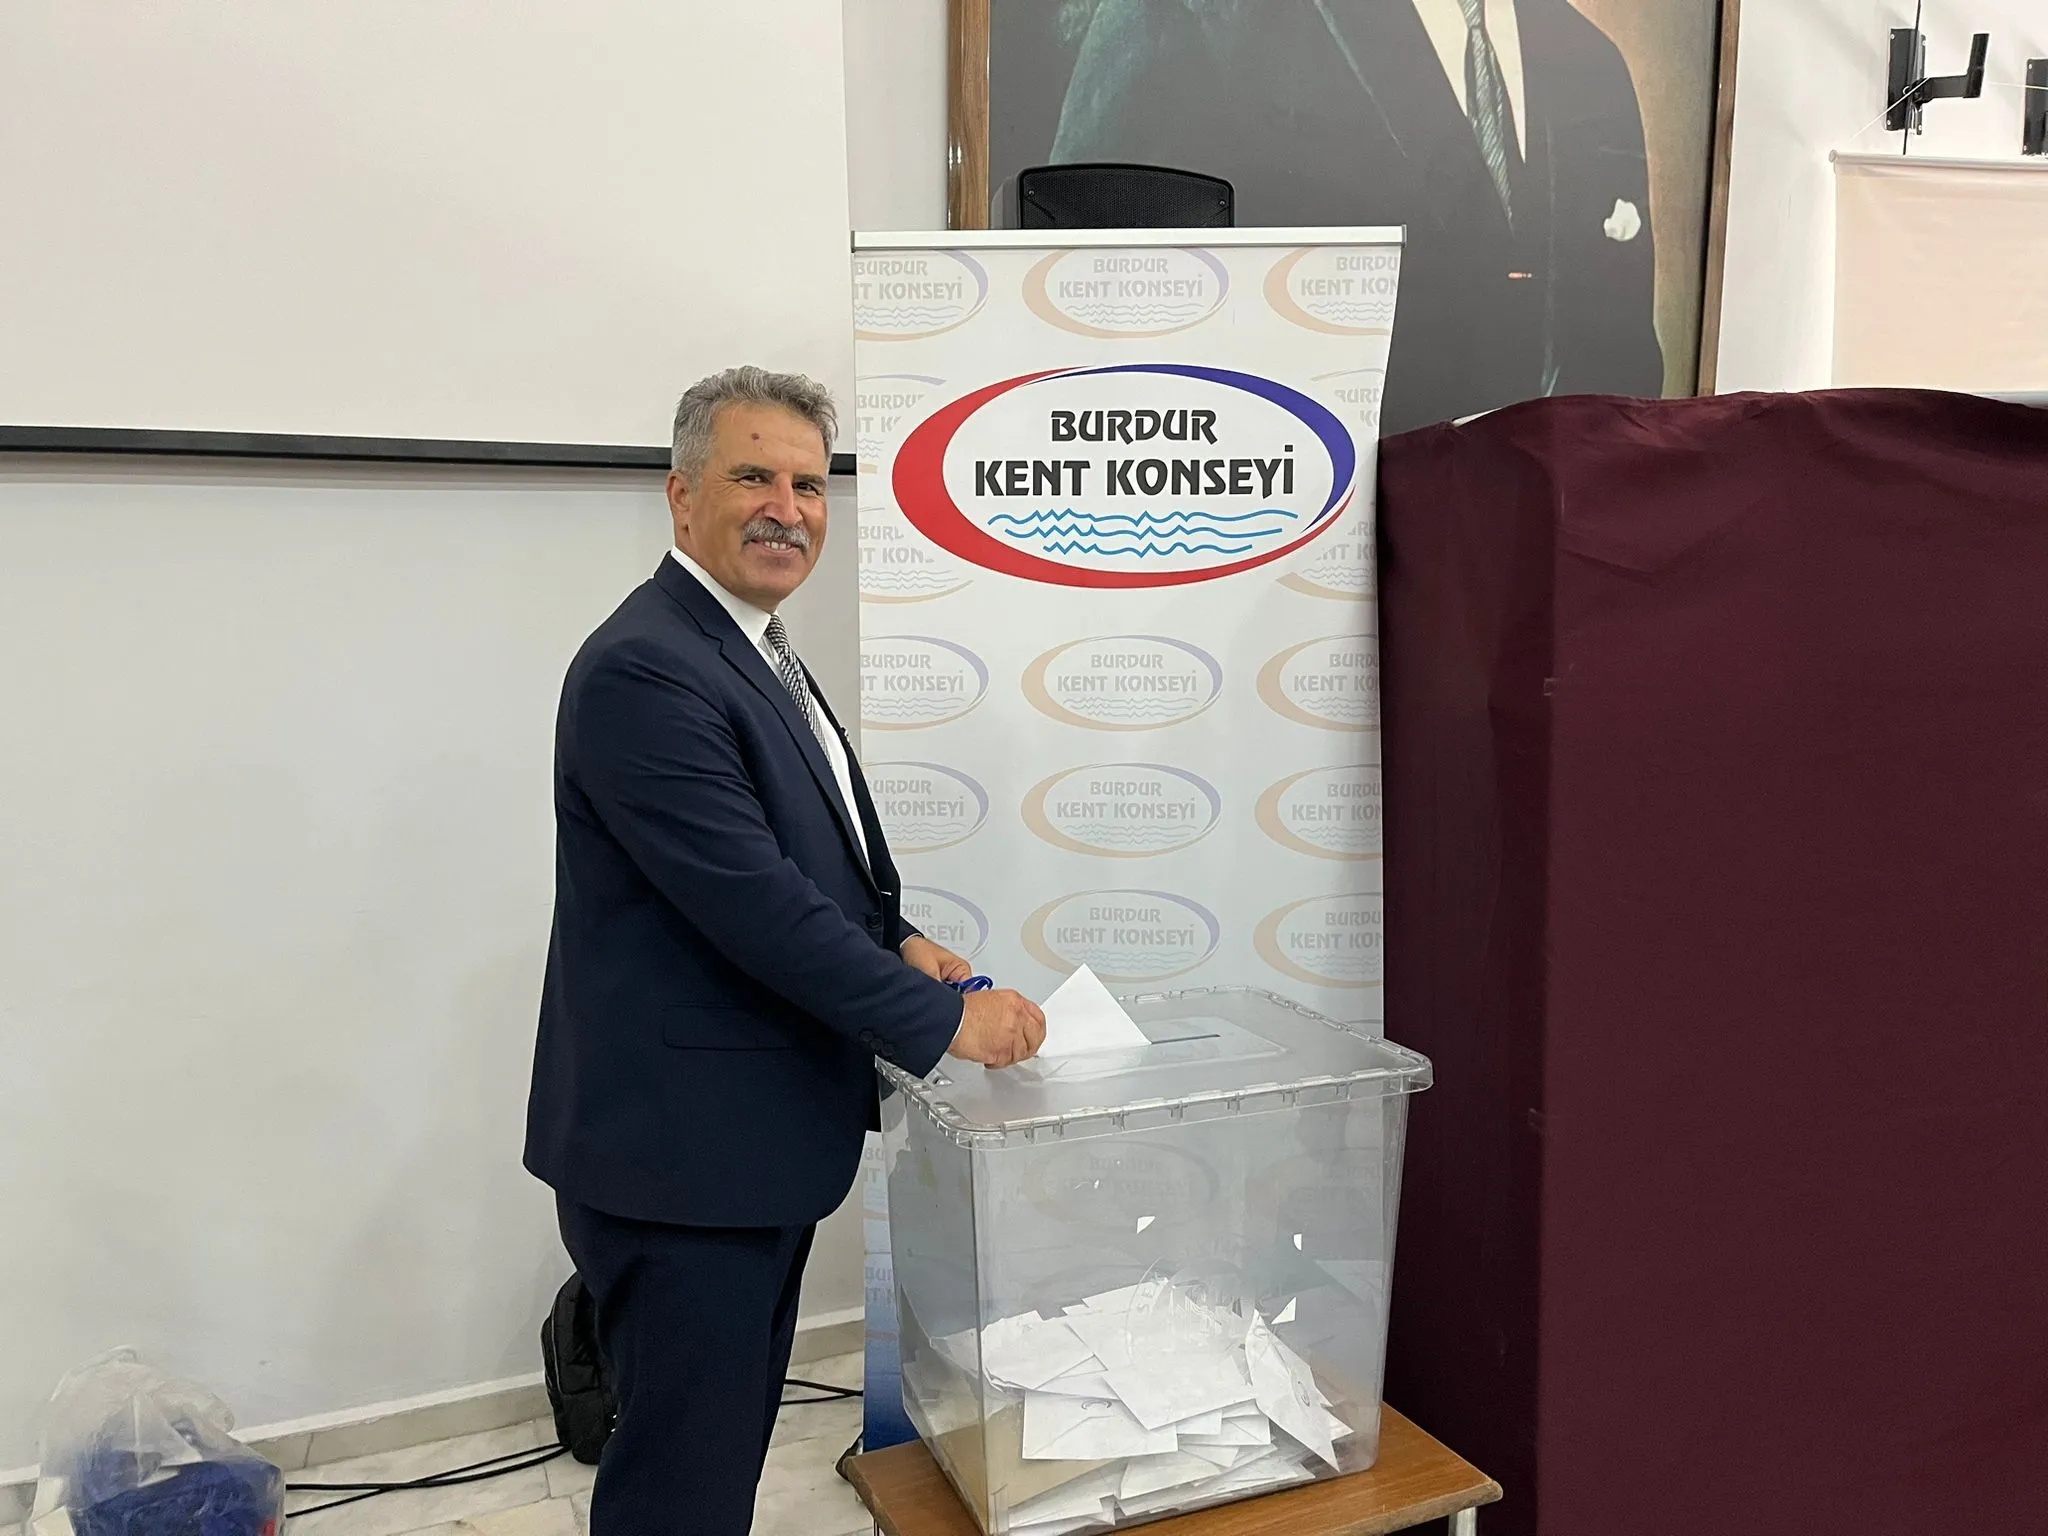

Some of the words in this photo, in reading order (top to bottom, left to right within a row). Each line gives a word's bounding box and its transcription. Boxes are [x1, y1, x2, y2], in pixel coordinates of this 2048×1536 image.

[854, 260, 928, 276] BURDUR
[1094, 258, 1168, 273] BURDUR
[880, 276, 962, 300] KONSEYİ
[1059, 280, 1111, 298] KENT
[1118, 273, 1203, 298] KONSEYİ
[1301, 279, 1354, 296] KENT
[857, 394, 925, 409] BURDU
[1051, 409, 1218, 445] BURDUR
[975, 460, 1091, 497] KENT
[1107, 444, 1294, 499] KONSEYİ
[882, 547, 935, 564] KON
[860, 654, 932, 669] BURDUR
[1091, 654, 1164, 669] BURDUR
[884, 669, 964, 694] KONSEYİ
[1057, 676, 1108, 692] KENT
[1115, 670, 1197, 692] KONSEYİ
[1294, 675, 1347, 692] KENT
[868, 780, 932, 795] URDUR
[1090, 781, 1162, 797] BURDUR
[885, 796, 964, 818] KONSEYİ
[1057, 802, 1107, 818] KENT
[1114, 797, 1196, 821] KONSEYİ
[1292, 804, 1344, 821] KENT
[1089, 906, 1161, 923] BURDUR
[921, 920, 964, 942] SEYİ
[1056, 927, 1106, 944] KENT
[1113, 923, 1195, 947] KONSEYİ
[1290, 932, 1342, 949] KENT
